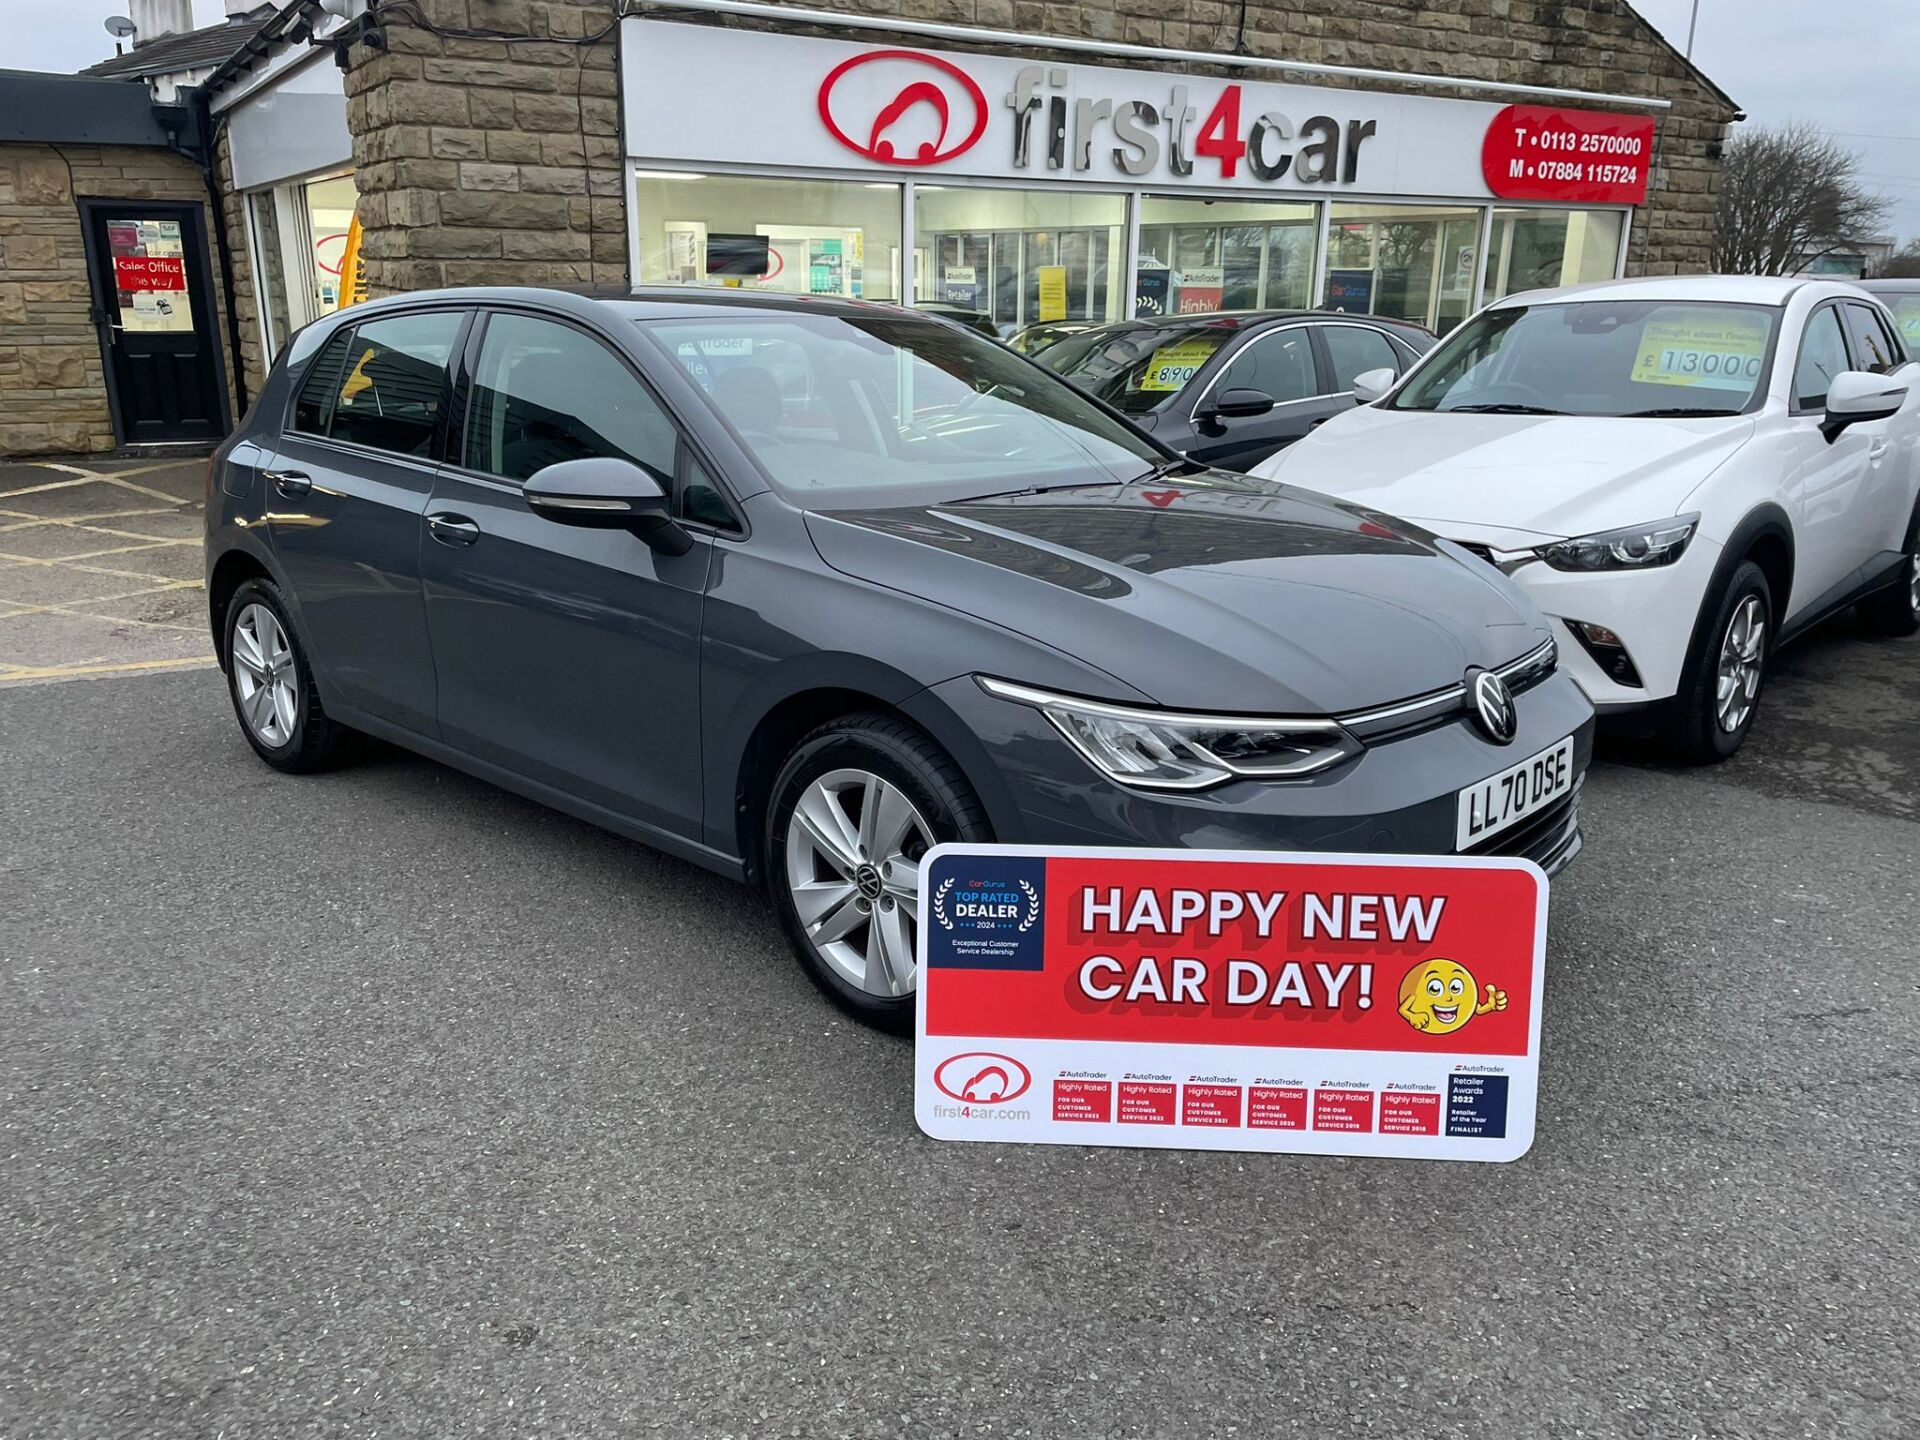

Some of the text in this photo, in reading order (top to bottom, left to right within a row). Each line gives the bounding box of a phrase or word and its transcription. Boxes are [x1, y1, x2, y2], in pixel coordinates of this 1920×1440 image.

[1006, 66, 1377, 184] first4car
[1515, 128, 1641, 155] T 0113 2570000
[1509, 159, 1637, 183] M 07884 115724
[119, 261, 179, 273] Sales Office
[1189, 273, 1220, 283] AutoTrader
[947, 288, 973, 300] Retailer
[1180, 298, 1219, 313] Highly
[1643, 351, 1760, 378] £ 13000
[1469, 747, 1566, 837] LL70 DSE
[969, 880, 1005, 888] CarGurus
[955, 892, 1019, 903] TOP RATED
[956, 904, 1018, 918] DEALER
[1081, 886, 1449, 943] HAPPY NEW
[976, 921, 995, 929] 2024
[952, 940, 988, 948] Exceptional
[981, 948, 1014, 956] Dealership
[1079, 955, 1375, 1010] CAR DAY!
[1462, 1065, 1504, 1073] AutoTrader
[1067, 1071, 1107, 1079] AutoTrader
[1262, 1078, 1303, 1086] AutoTrader
[1453, 1077, 1484, 1085] Retailer
[1059, 1083, 1107, 1092] Highly Rated
[1123, 1086, 1147, 1094] Highly
[1394, 1083, 1436, 1091] AutoTrader
[1188, 1088, 1212, 1097] Highly
[1253, 1091, 1277, 1099] Highly
[1320, 1093, 1344, 1102] Highly
[1386, 1095, 1436, 1104] Highly Rated
[933, 1105, 1031, 1120] first4car.com
